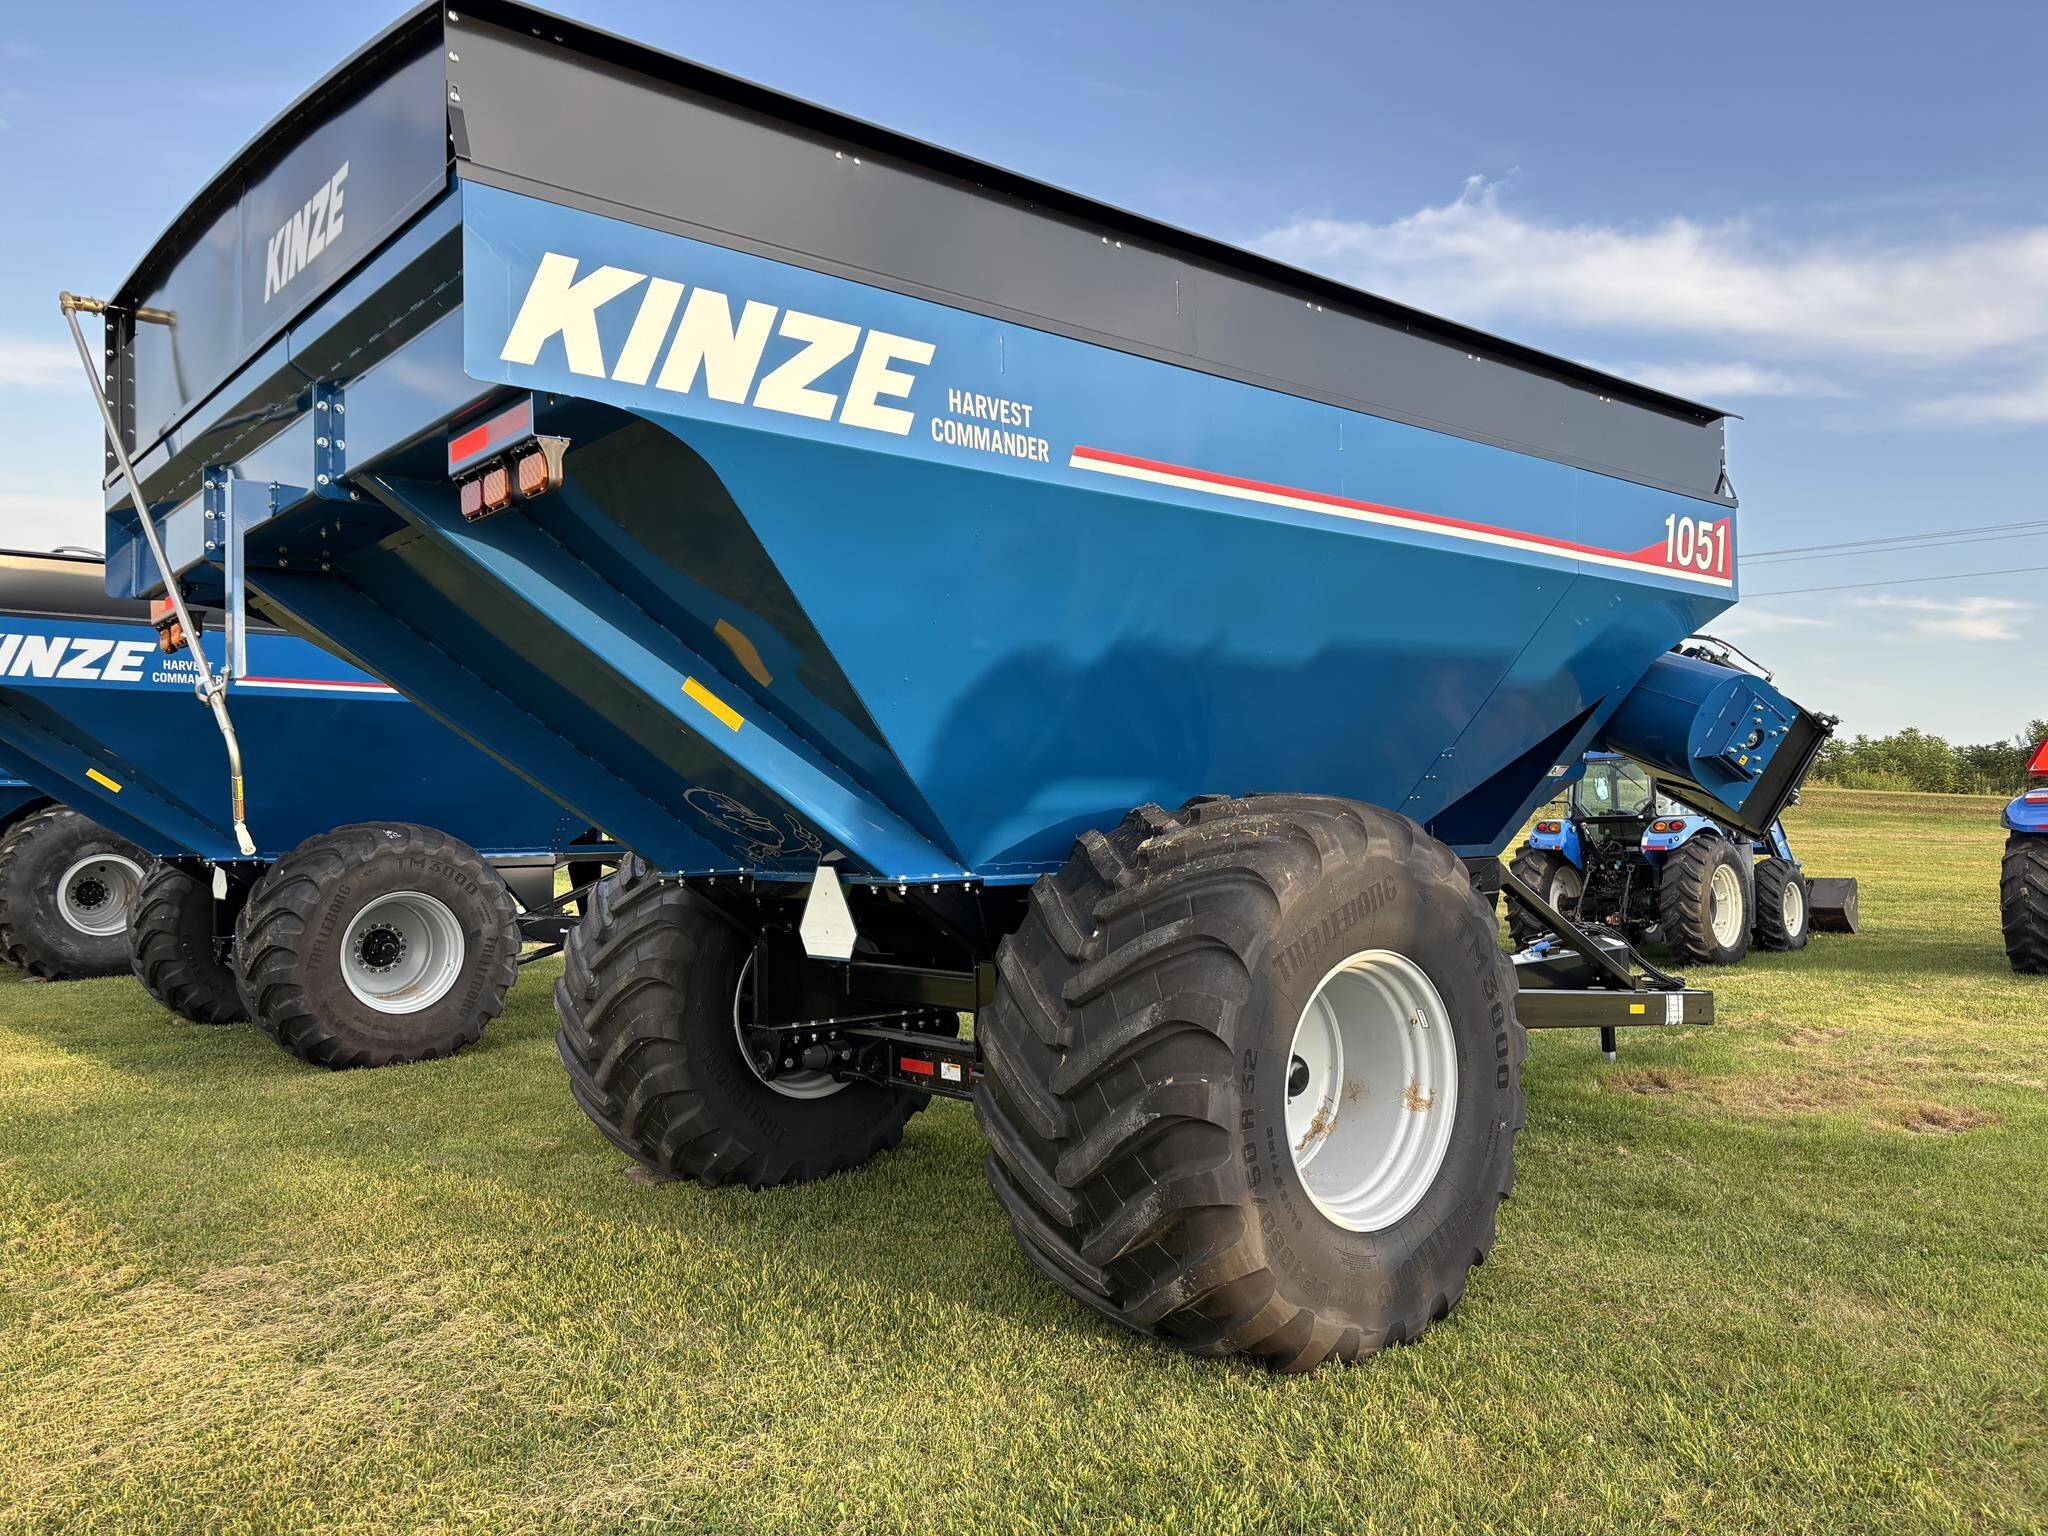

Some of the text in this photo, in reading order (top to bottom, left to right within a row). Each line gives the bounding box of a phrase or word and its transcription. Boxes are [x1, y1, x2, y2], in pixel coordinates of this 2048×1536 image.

[264, 160, 349, 304] KINZE
[500, 251, 936, 436] KINZE
[949, 388, 1032, 429] HARVEST
[931, 418, 1049, 463] COMMANDER
[1665, 513, 1725, 573] 1051
[0, 634, 157, 682] INZE
[163, 659, 213, 671] HARVET
[397, 857, 478, 896] TM3000
[305, 883, 352, 973] TRELLEBORG
[1272, 874, 1398, 983] TRELLEBORG
[459, 935, 499, 1019] TRELLEBORG
[1455, 912, 1510, 1092] TM3000
[1240, 1049, 1259, 1099] 32
